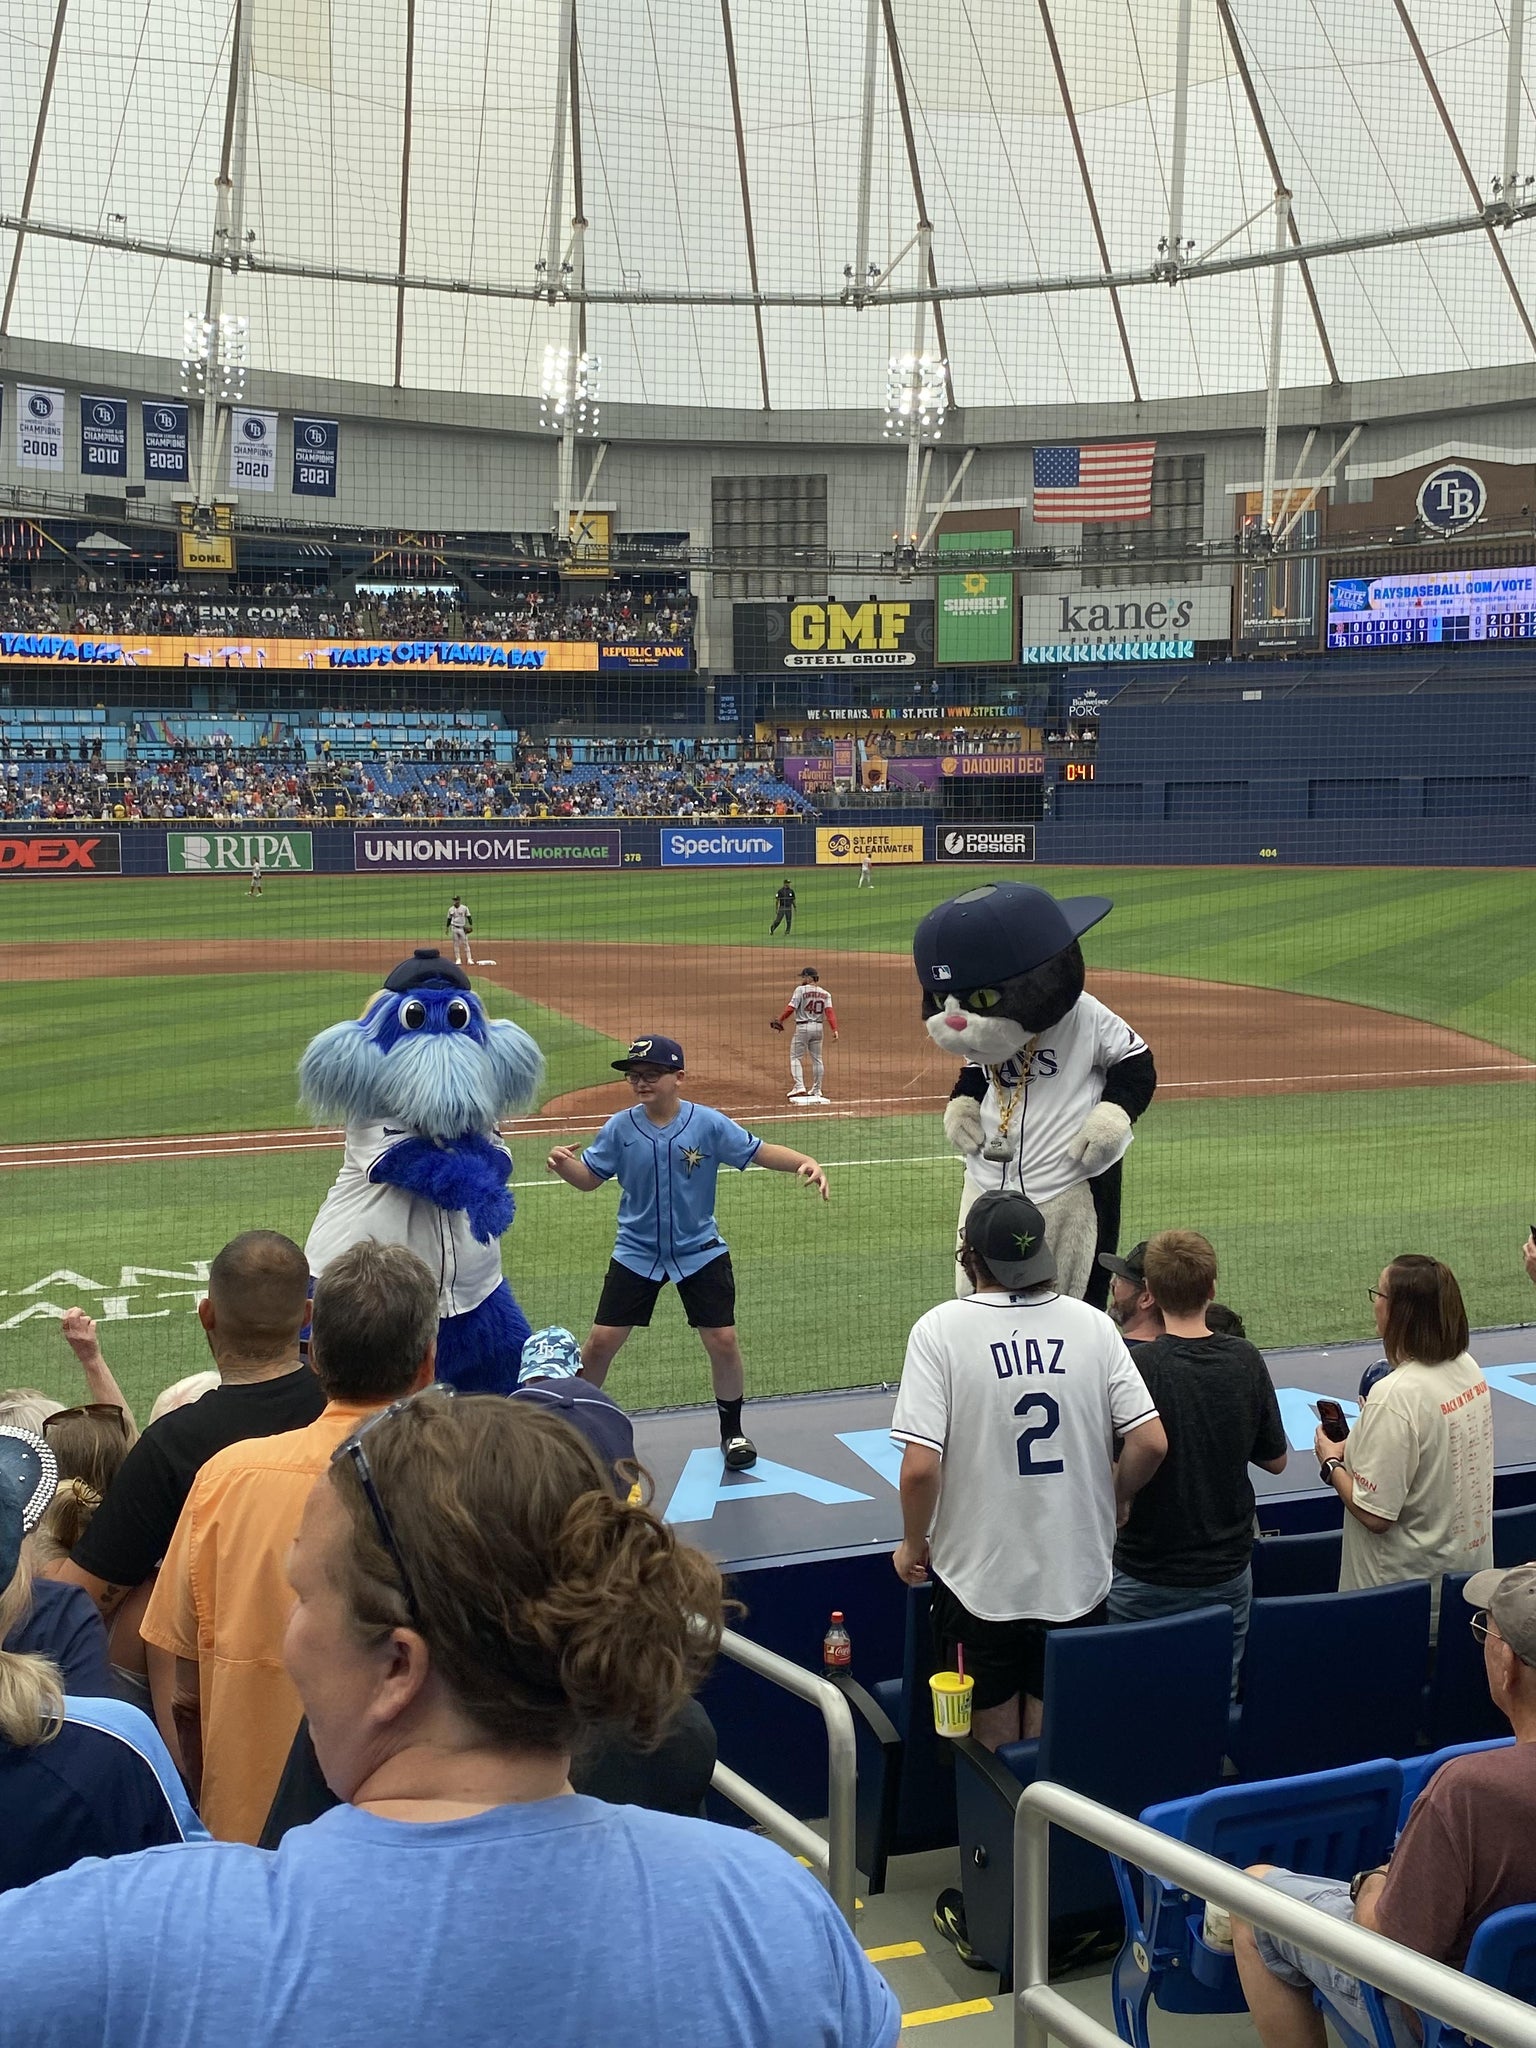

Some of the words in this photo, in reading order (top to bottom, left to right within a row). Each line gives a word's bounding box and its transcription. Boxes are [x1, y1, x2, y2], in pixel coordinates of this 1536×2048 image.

[34, 399, 48, 414] TB
[97, 407, 111, 422] TB
[158, 413, 173, 427] TB
[20, 424, 61, 436] CHAMPIONS
[248, 422, 261, 437] TB
[309, 429, 322, 443] TB
[84, 432, 124, 443] CHAMPIONS
[146, 437, 185, 448] CHAMPIONS
[24, 440, 58, 457] 2008
[89, 447, 119, 464] 2010
[234, 445, 273, 458] CHAMPIONS
[150, 453, 183, 470] 2020
[296, 452, 335, 464] CHAMPIONS
[237, 461, 269, 478] 2020
[300, 468, 329, 485] 2021
[1430, 479, 1475, 520] TB
[190, 554, 226, 563] DONE.
[1336, 586, 1367, 604] VOTE
[1373, 578, 1532, 601] RAYSBASEBALL.COM/VOTE
[943, 596, 1007, 611] SUNBELT
[1058, 595, 1194, 632] kane's
[791, 603, 911, 650] GMF
[1353, 622, 1359, 632] 0
[1366, 621, 1372, 631] 0
[1379, 621, 1385, 631] 0
[1392, 620, 1398, 630] 0
[1406, 620, 1411, 629] 0
[1419, 619, 1424, 629] 0
[1432, 617, 1438, 627] 0
[1475, 615, 1481, 625] 0
[1490, 615, 1496, 625] 2
[1504, 614, 1510, 624] 0
[1519, 613, 1525, 623] 3
[1071, 633, 1180, 645] FURNITURE
[1, 631, 78, 660] TAMPA
[330, 646, 392, 667] TARPS
[392, 643, 436, 664] OFF
[436, 642, 507, 667] TAMPA
[508, 648, 548, 670] BAY
[602, 647, 652, 657] REPUBLIC
[655, 647, 685, 657] BANK
[794, 656, 846, 665] STEEL
[853, 654, 907, 664] GROUP
[1072, 697, 1109, 706] Budweiser
[807, 709, 820, 720] WE
[829, 709, 846, 720] THE
[847, 709, 870, 719] RAYS.
[871, 708, 884, 719] WE
[947, 705, 1025, 717] WWW.STPETE.ORG
[962, 757, 1015, 775] DAIQUIRI
[1018, 757, 1045, 774] DEC
[1066, 764, 1094, 781] 0:41
[214, 835, 301, 868] RIPA
[531, 847, 609, 860] MORTGAGE
[670, 834, 763, 860] Spectrum
[853, 844, 914, 854] CLEARWATER
[1259, 848, 1277, 858] 404
[624, 853, 642, 862] 378
[804, 1000, 825, 1014] 40
[535, 1338, 555, 1359] TB
[990, 1329, 1066, 1380] DÍAZ
[1440, 1399, 1457, 1415] BACK
[1456, 1396, 1464, 1408] IN
[1462, 1388, 1475, 1404] THE
[1014, 1391, 1065, 1477] 2
